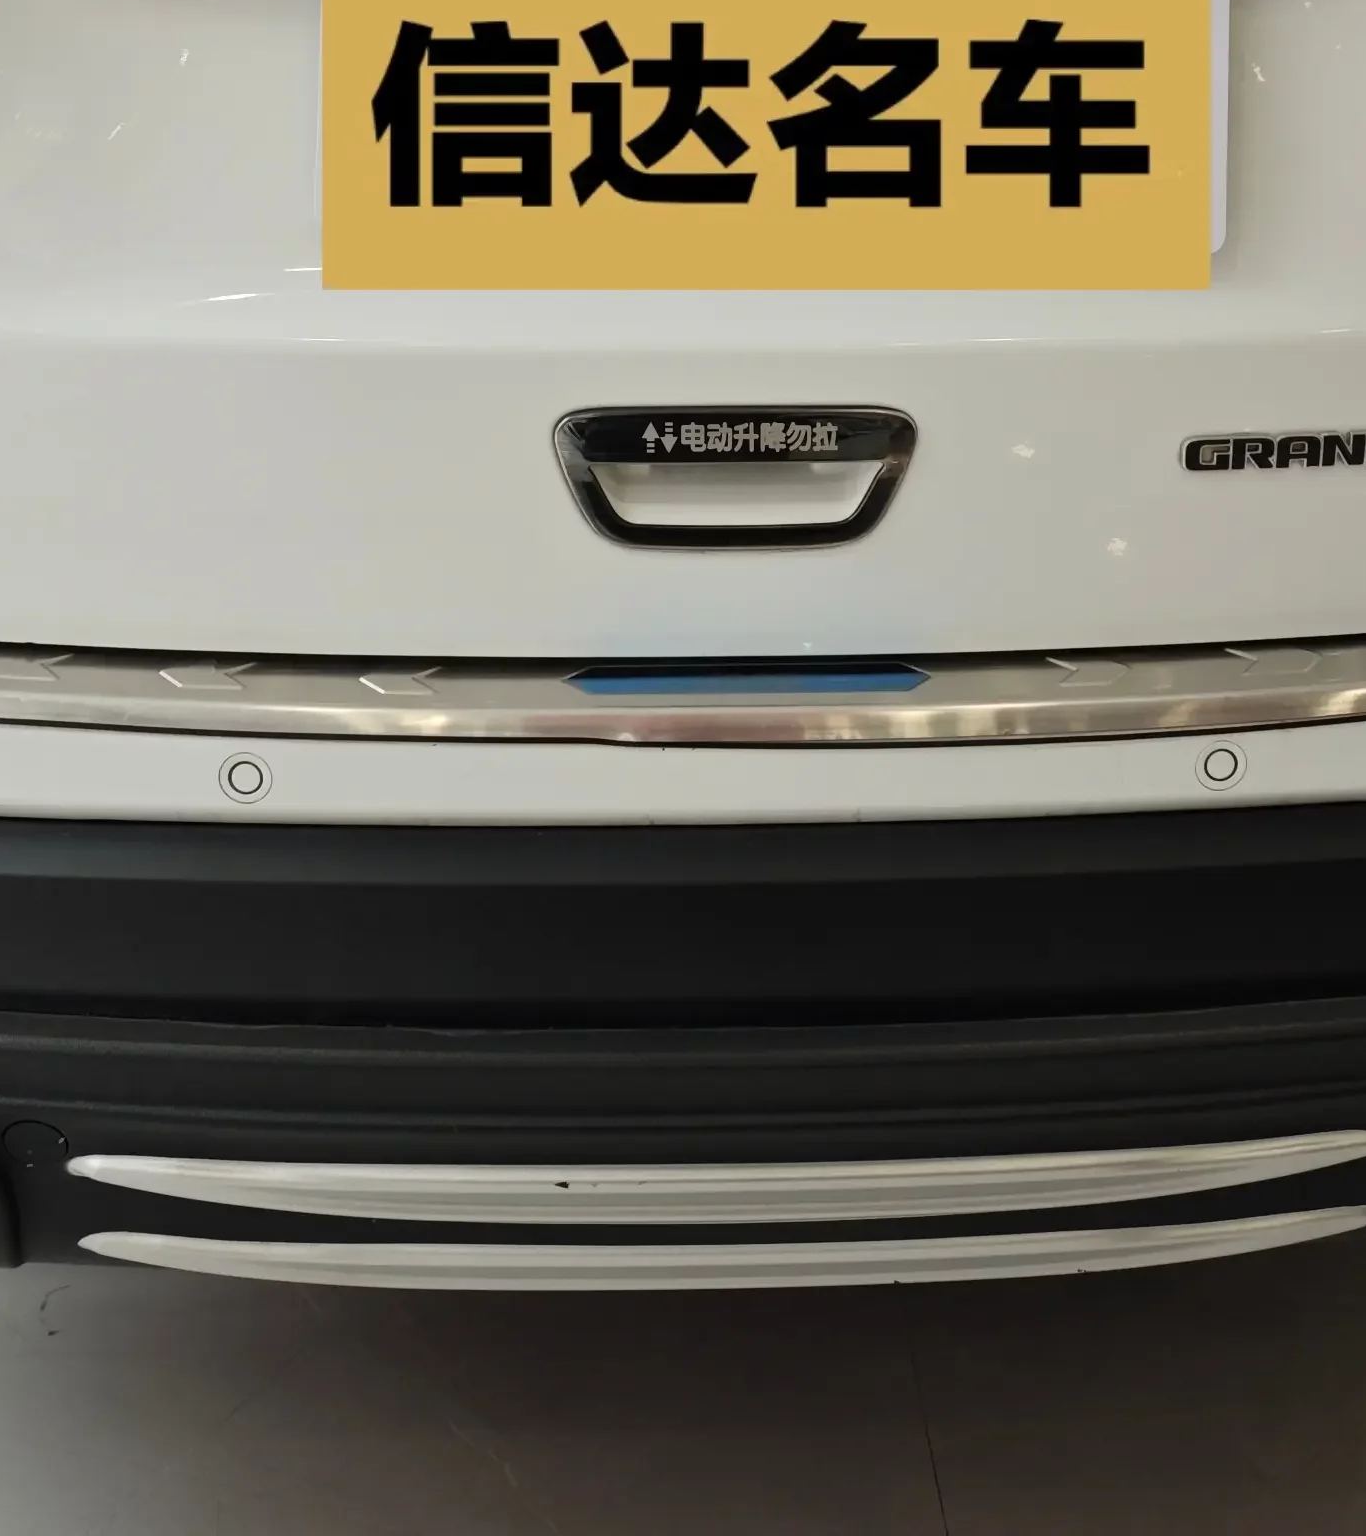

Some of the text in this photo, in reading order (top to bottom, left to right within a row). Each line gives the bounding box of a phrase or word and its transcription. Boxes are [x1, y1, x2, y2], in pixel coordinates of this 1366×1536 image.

[680, 421, 839, 453] 电动升降勿拉
